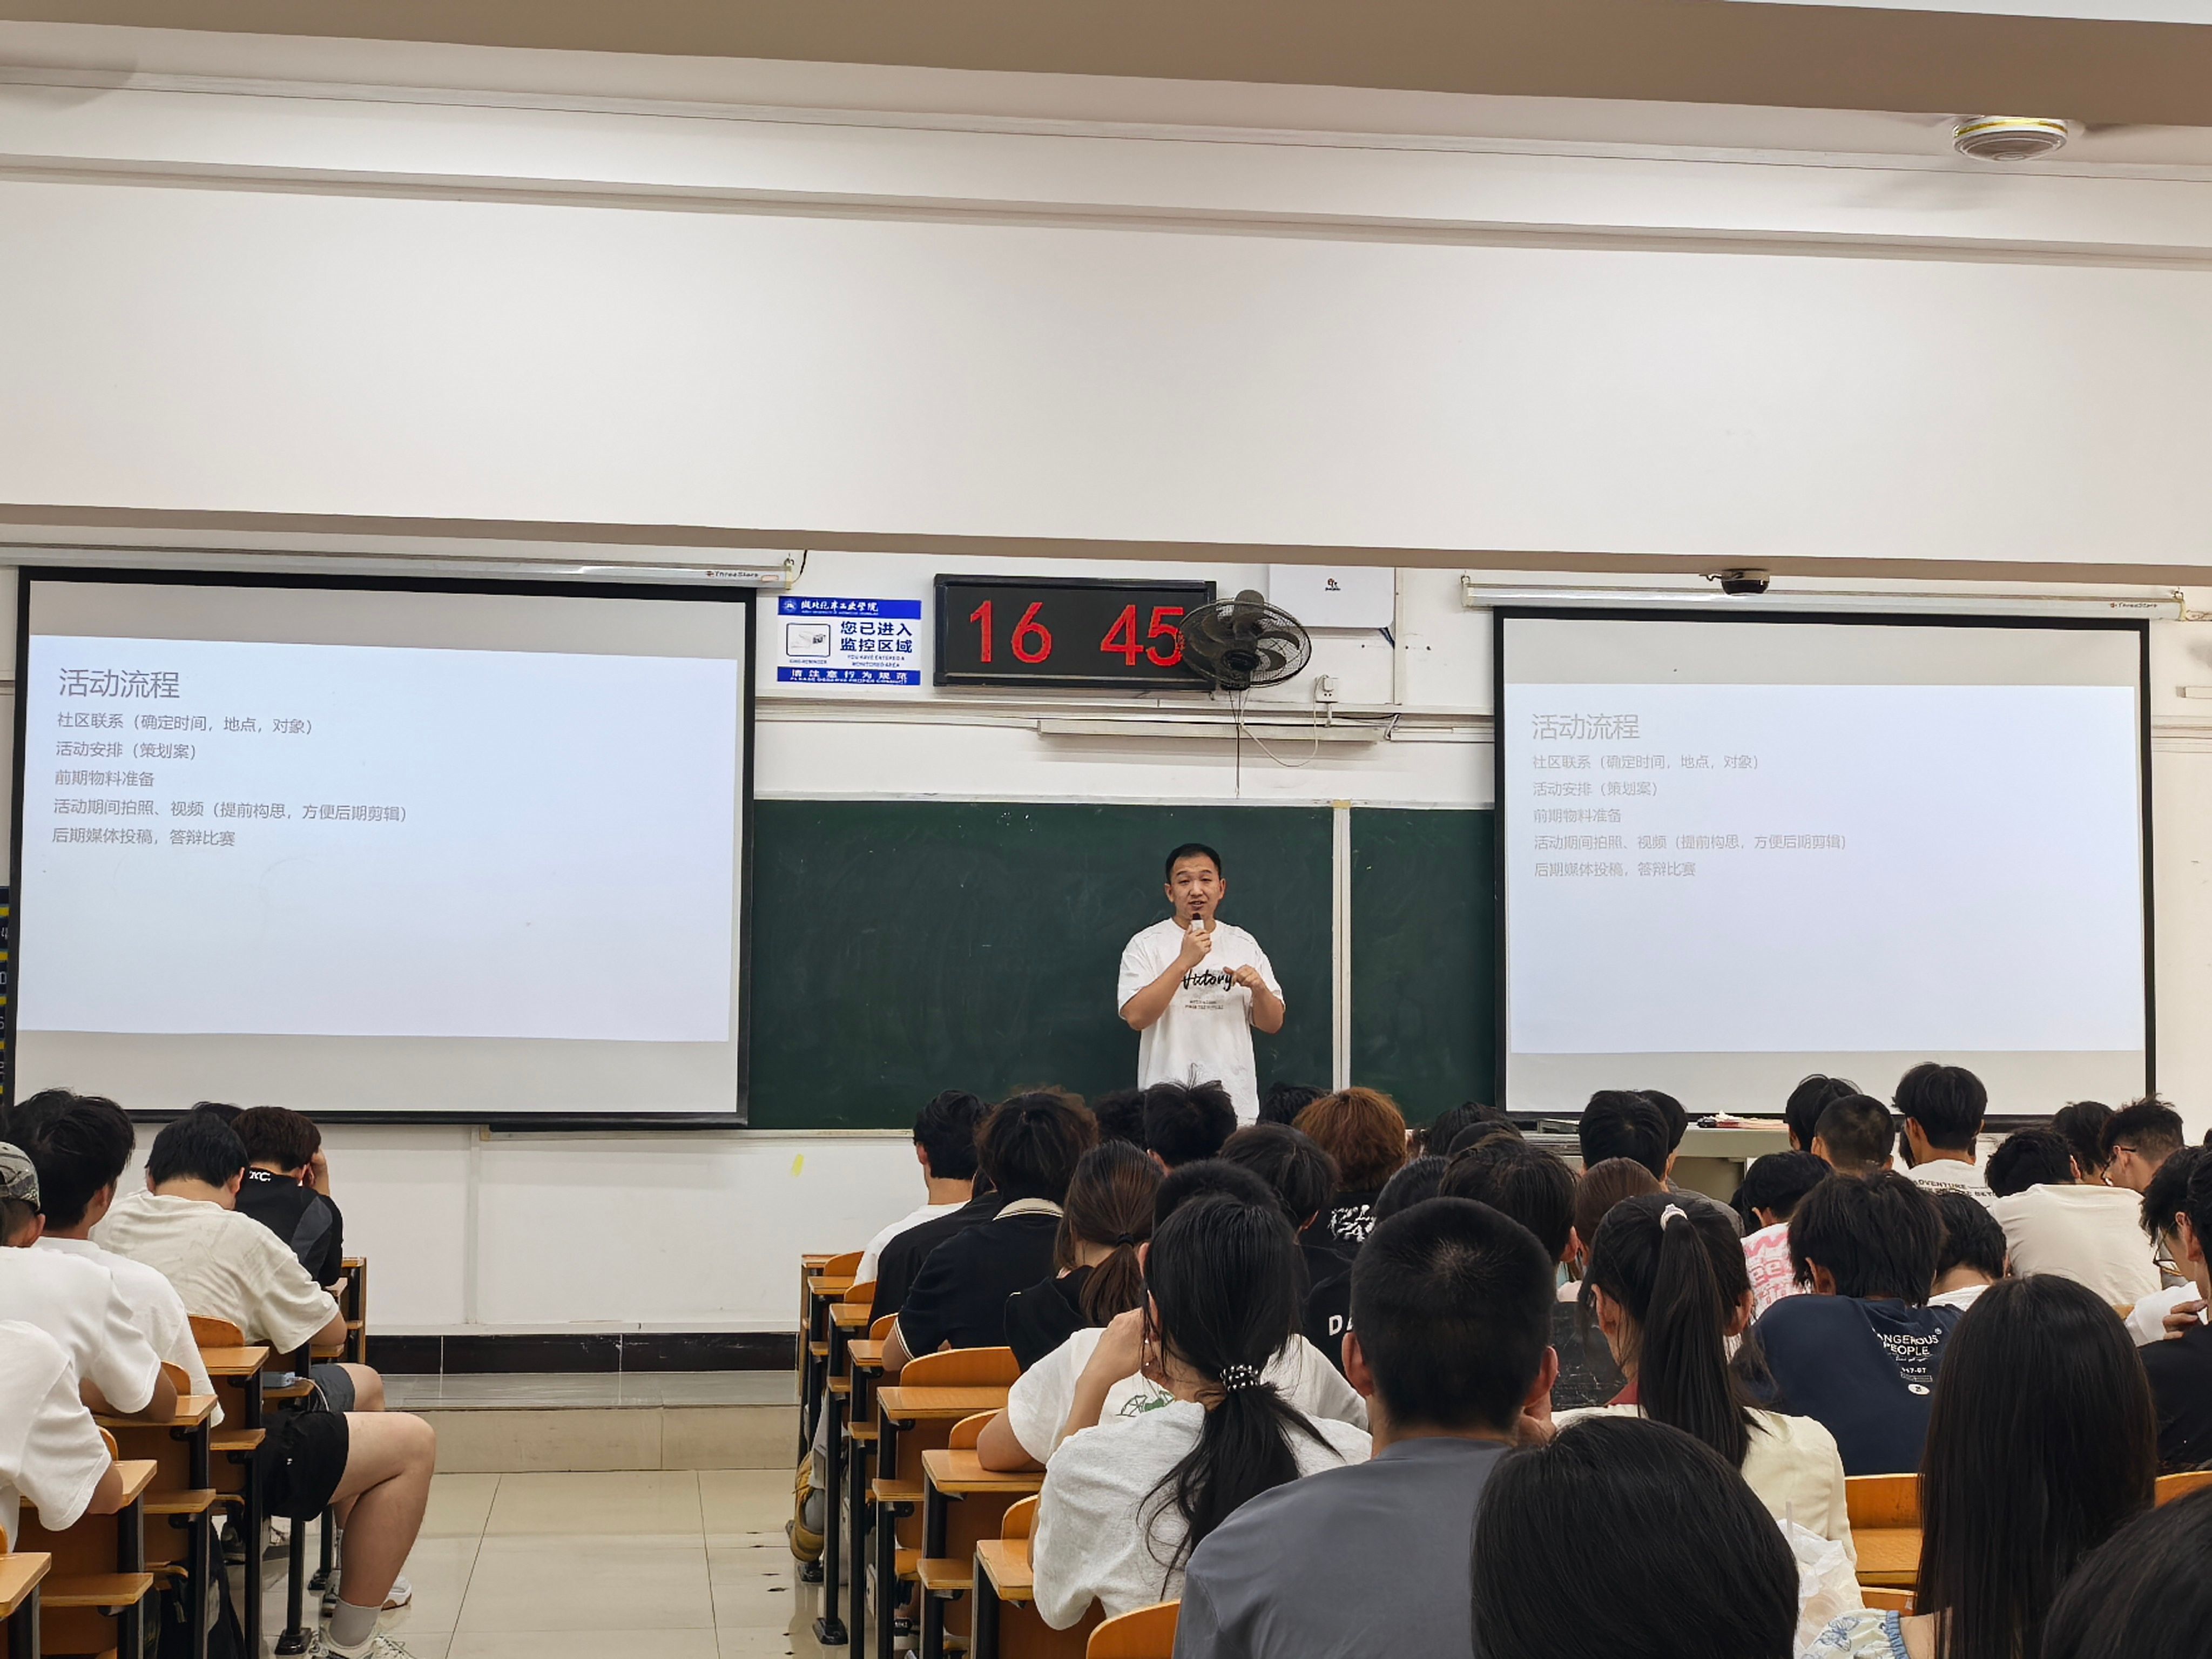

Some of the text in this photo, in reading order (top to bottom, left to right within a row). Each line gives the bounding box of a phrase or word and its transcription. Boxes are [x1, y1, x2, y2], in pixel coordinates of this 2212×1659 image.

[840, 621, 913, 637] 您已进入
[970, 599, 1186, 667] 16 45
[839, 638, 913, 653] 监控区域
[59, 667, 180, 699] 活动流程
[1532, 712, 1641, 740] 活动流程
[56, 740, 196, 760] 活动安排（策划案）
[55, 768, 155, 787] 前期物料准备
[1533, 781, 1657, 797] 活动安排（策划案）
[1533, 807, 1621, 824] 前期物料准备
[52, 827, 235, 847] 后期媒体投稿，答辩比赛
